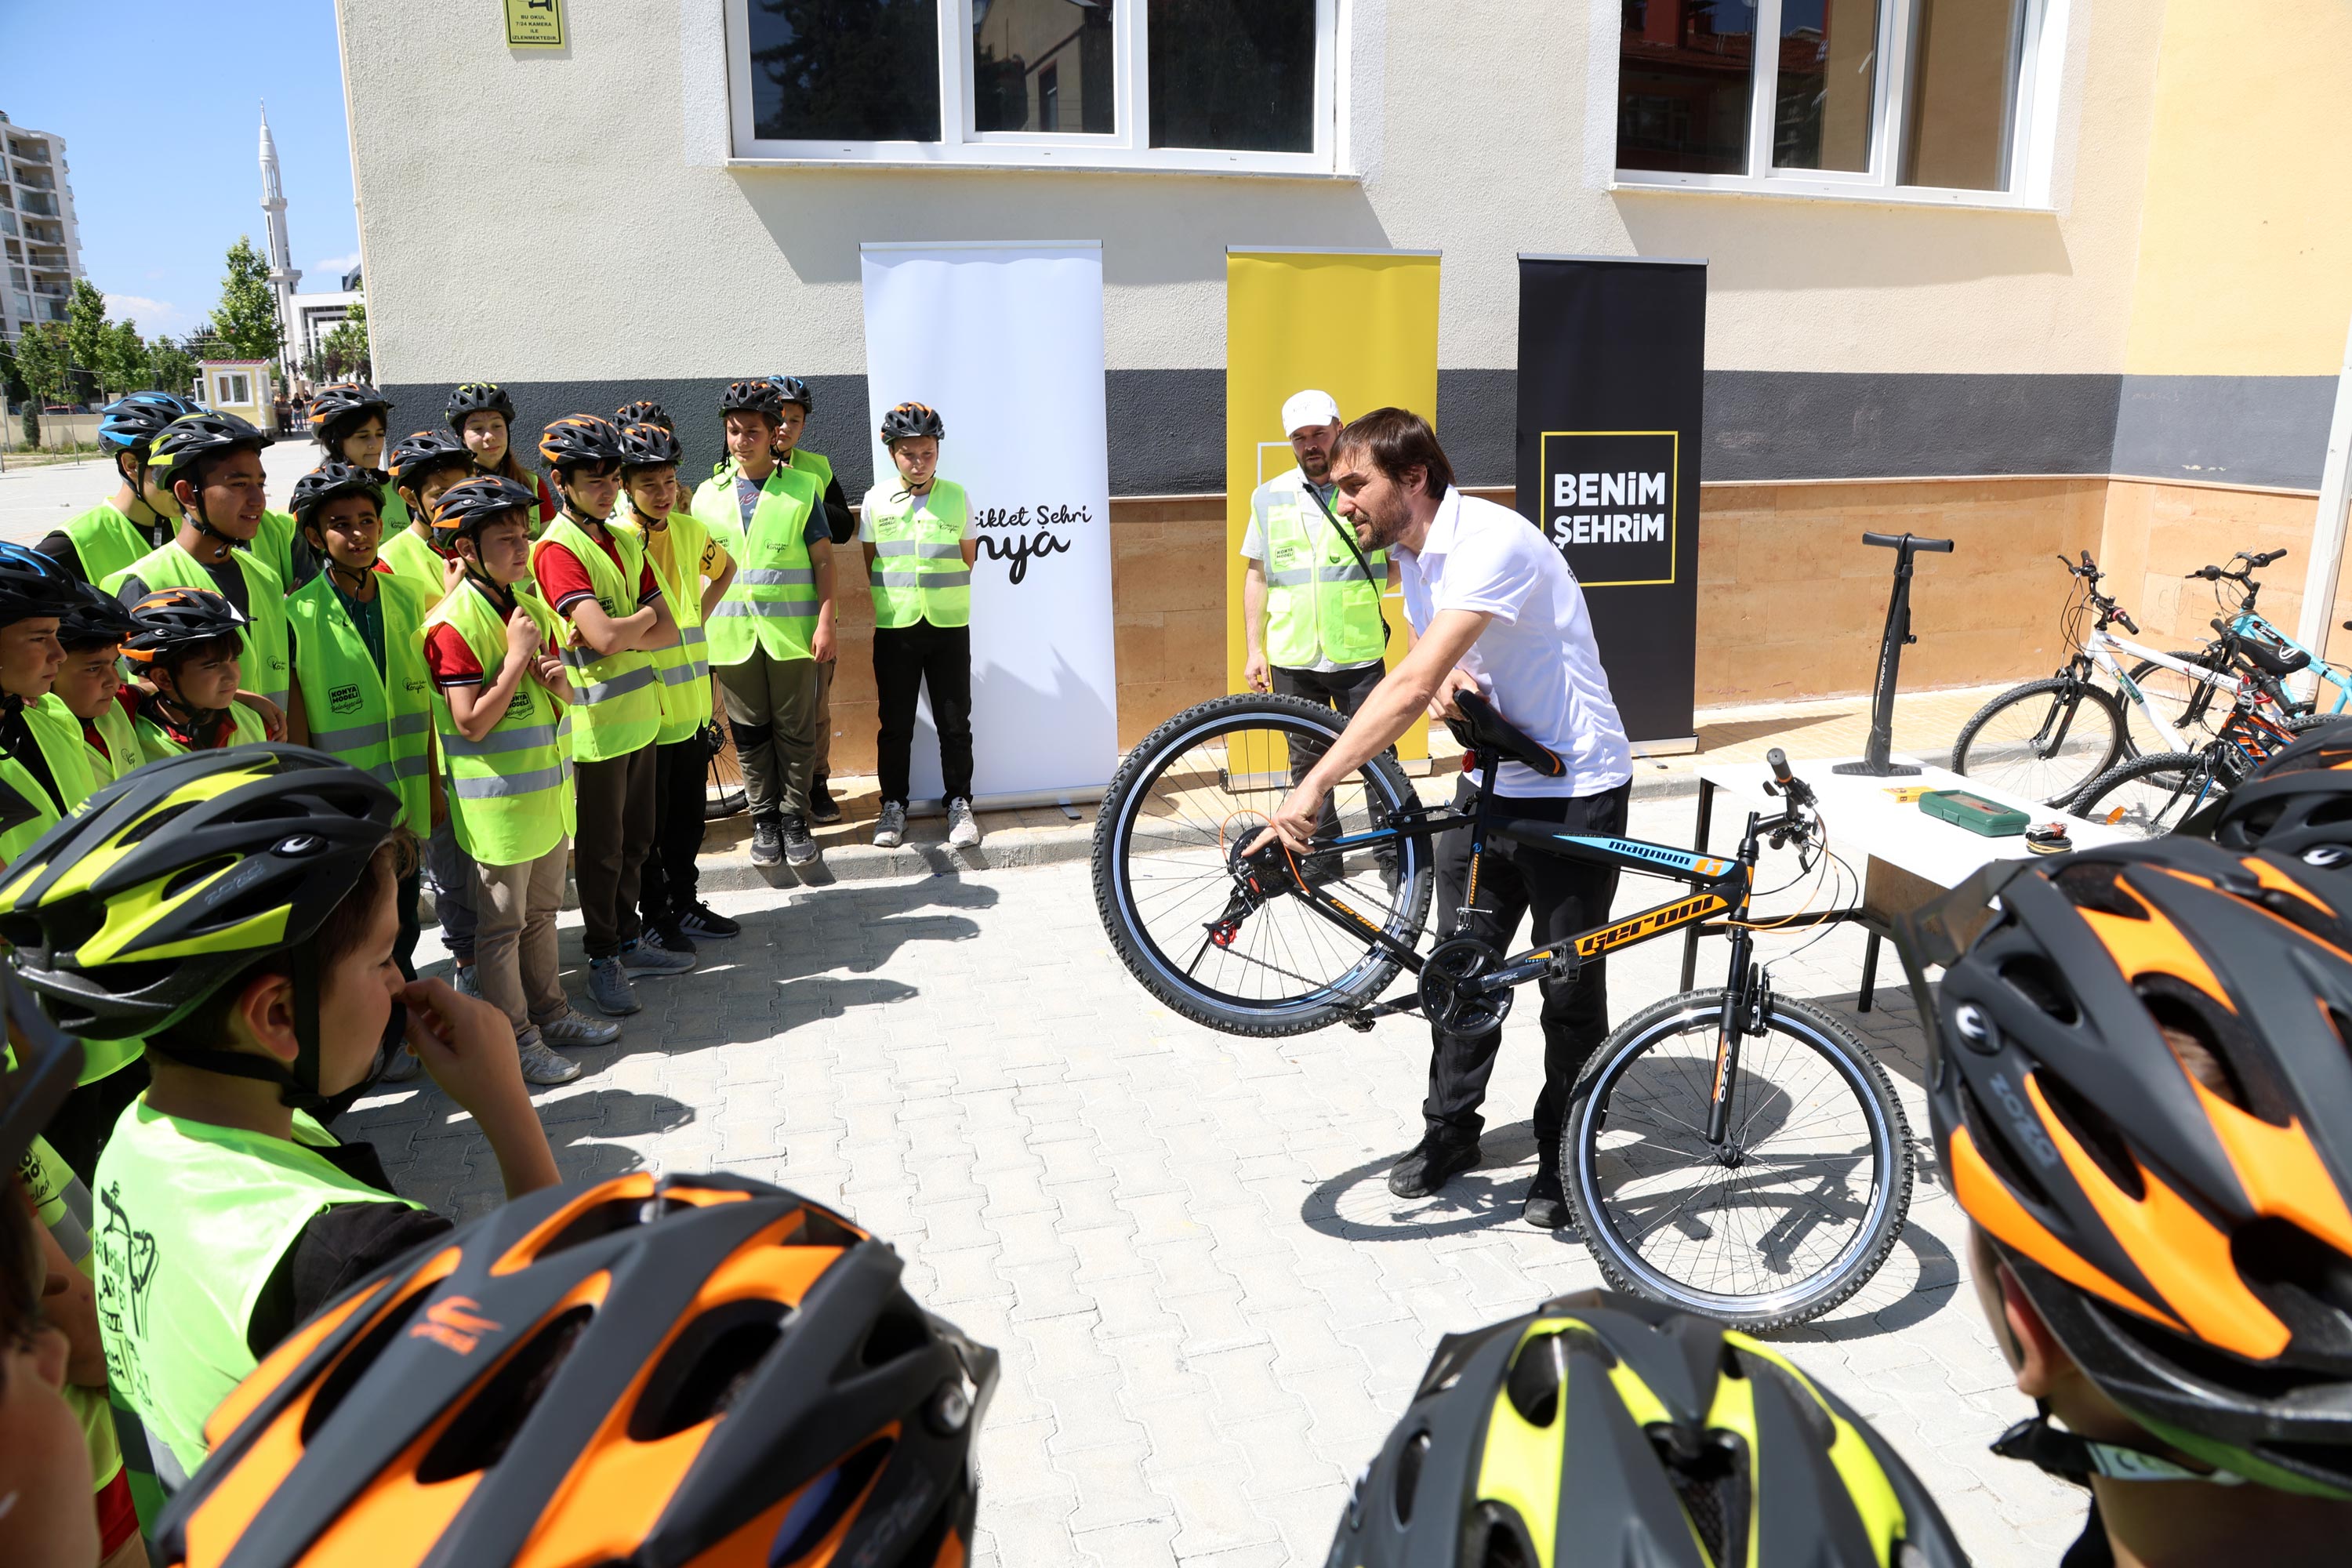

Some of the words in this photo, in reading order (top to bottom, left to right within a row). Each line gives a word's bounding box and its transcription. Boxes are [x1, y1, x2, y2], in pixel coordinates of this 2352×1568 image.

[1554, 472, 1666, 506] BENİM
[975, 506, 1032, 528] iklet
[1036, 504, 1093, 529] Şehri
[1553, 513, 1665, 550] ŞEHRİM
[975, 531, 1071, 585] nya
[331, 686, 357, 698] KONYA
[1609, 841, 1690, 866] magnum
